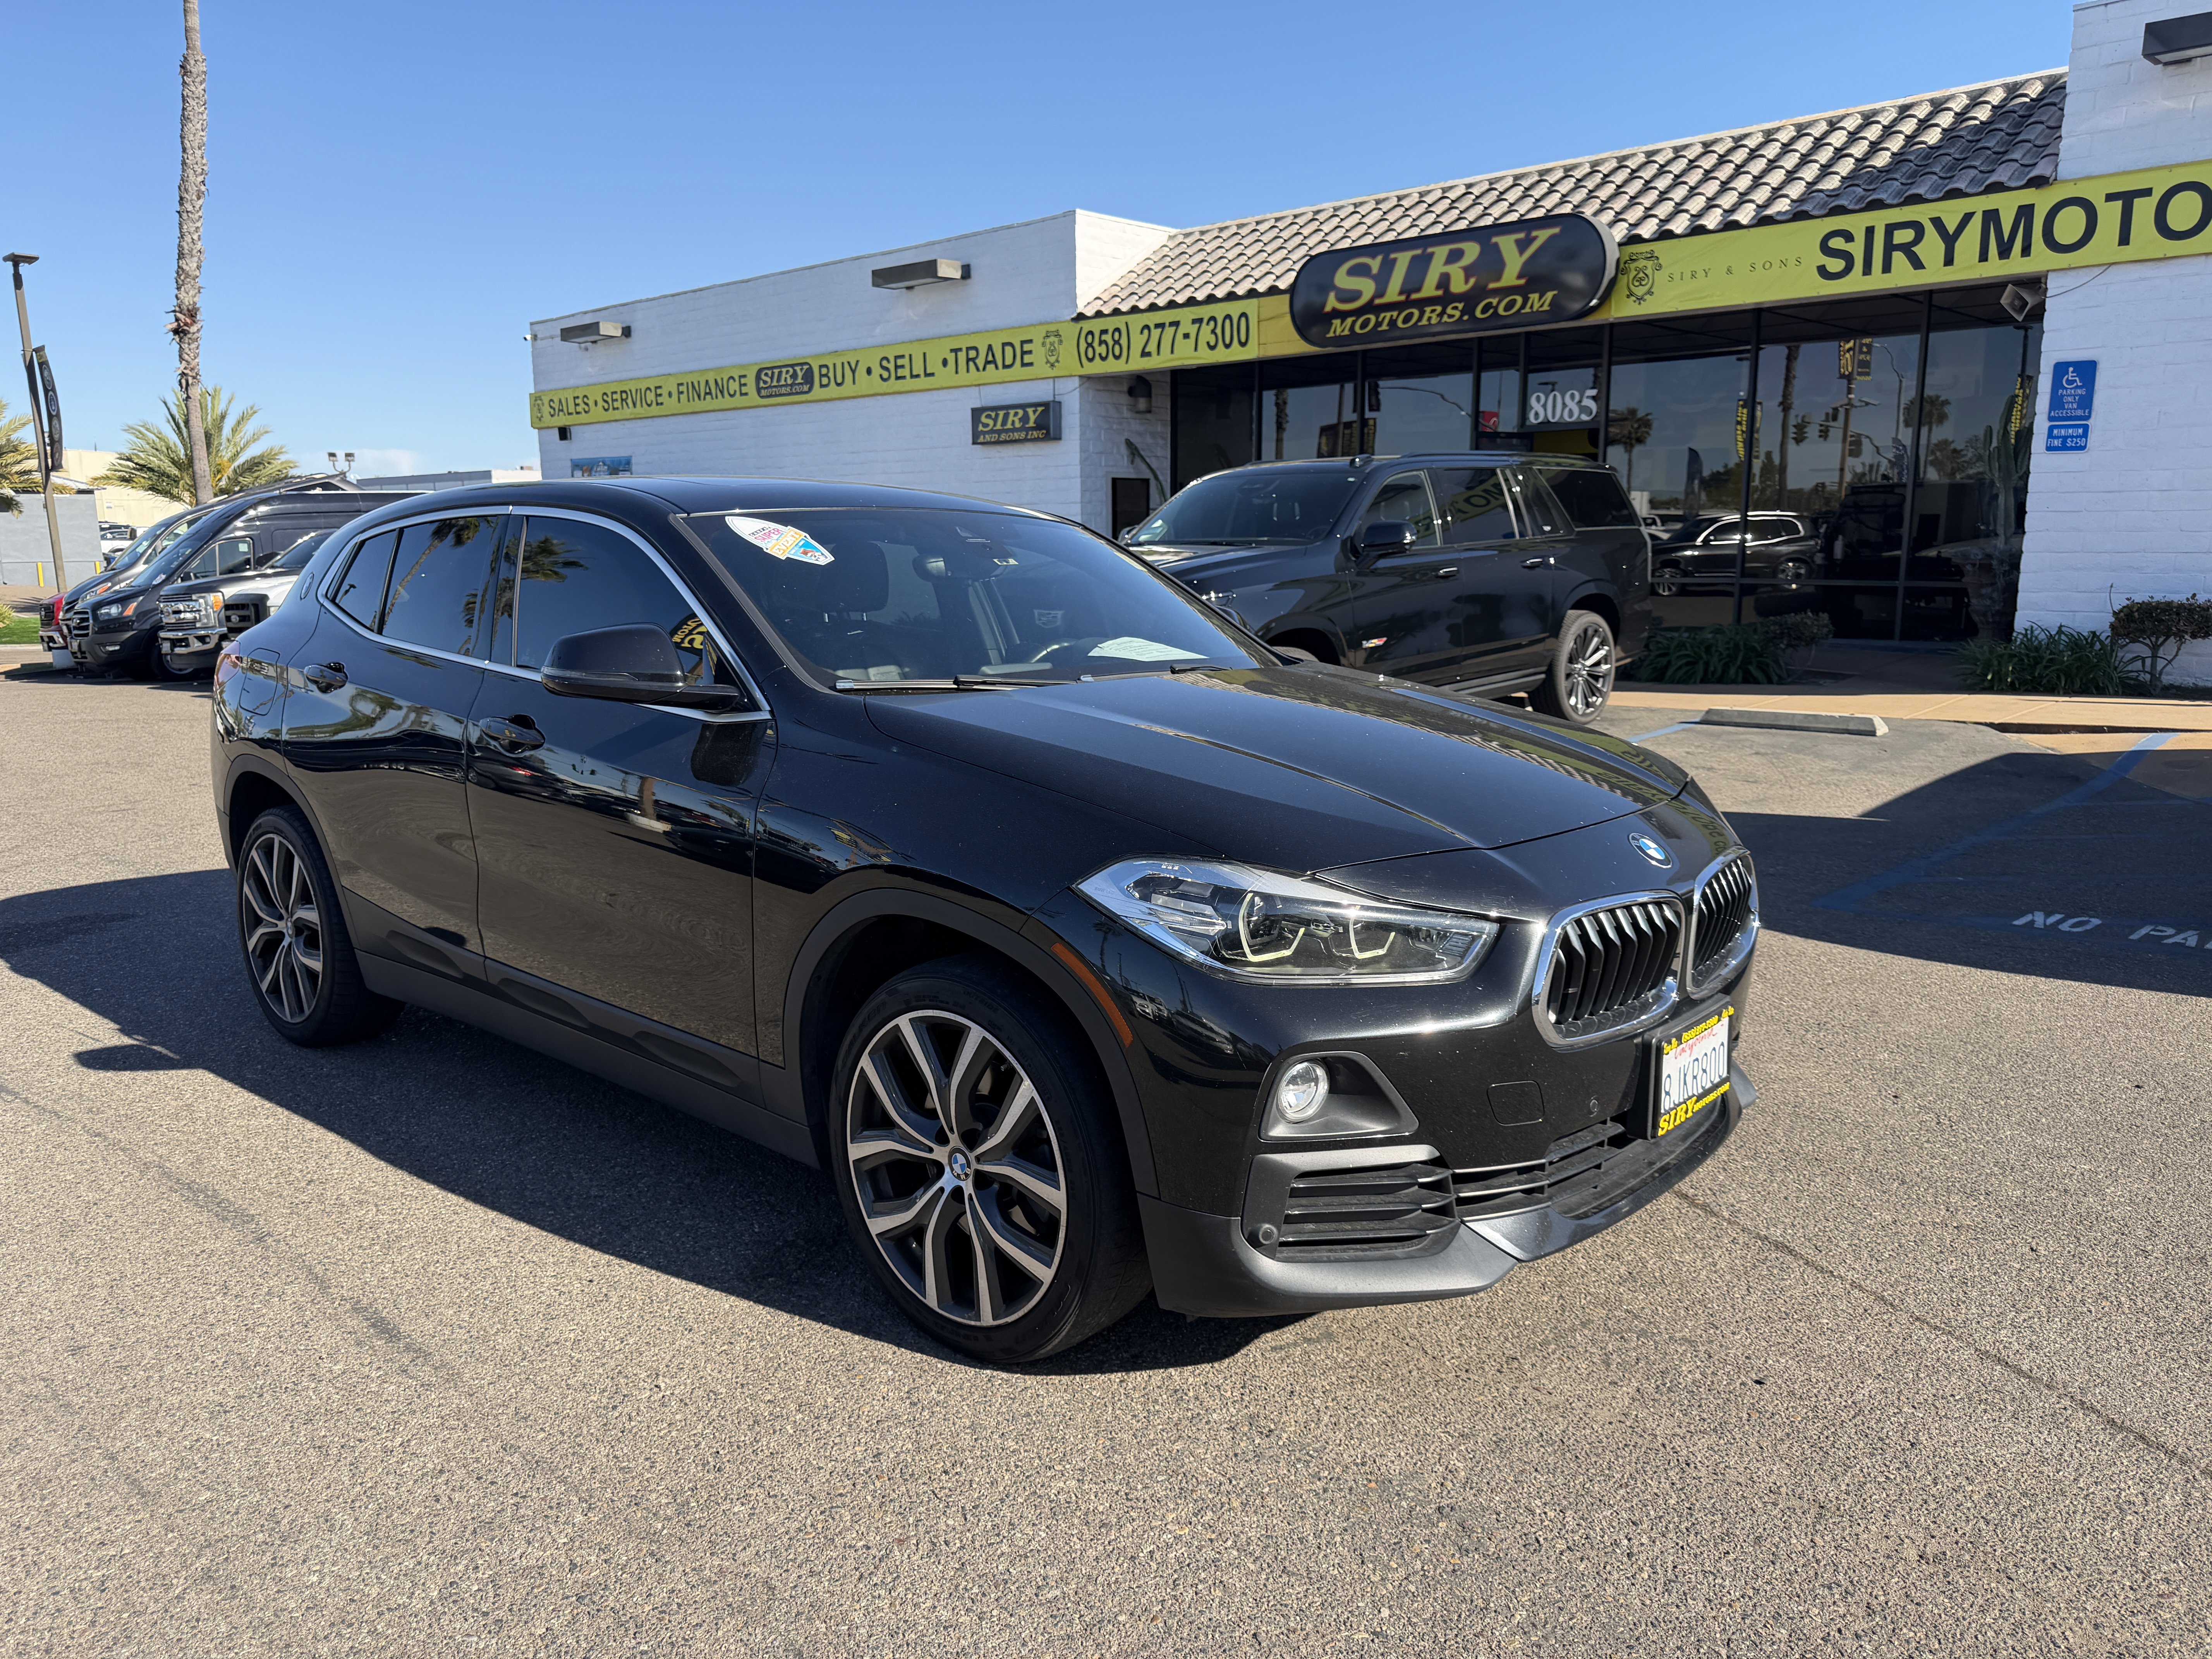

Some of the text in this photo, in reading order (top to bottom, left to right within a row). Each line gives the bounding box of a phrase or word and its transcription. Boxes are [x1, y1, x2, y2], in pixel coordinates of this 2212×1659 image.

[1816, 180, 2212, 281] SIRYMOTO
[1323, 226, 1562, 314] SIRY
[1667, 256, 1803, 283] SIRY & SONS
[1326, 290, 1558, 338] MOTORS.COM
[1077, 312, 1250, 368] (858) 277-7300
[819, 339, 1034, 388] BUY SELL TRADE
[759, 365, 810, 388] SIRY
[548, 374, 749, 417] SALES SERVICE FINANCE
[760, 385, 810, 396] MOTORS.COM
[978, 407, 1045, 431] SIRY
[1528, 389, 1598, 424] 8085
[977, 430, 1046, 443] AND SONS INC
[2047, 438, 2086, 447] FINE $250
[2053, 428, 2083, 436] MINIMUM
[754, 528, 784, 542] SUPER
[2012, 911, 2102, 932] NO
[1663, 1041, 1725, 1111] 8JKR800
[952, 1168, 971, 1180] BMW
